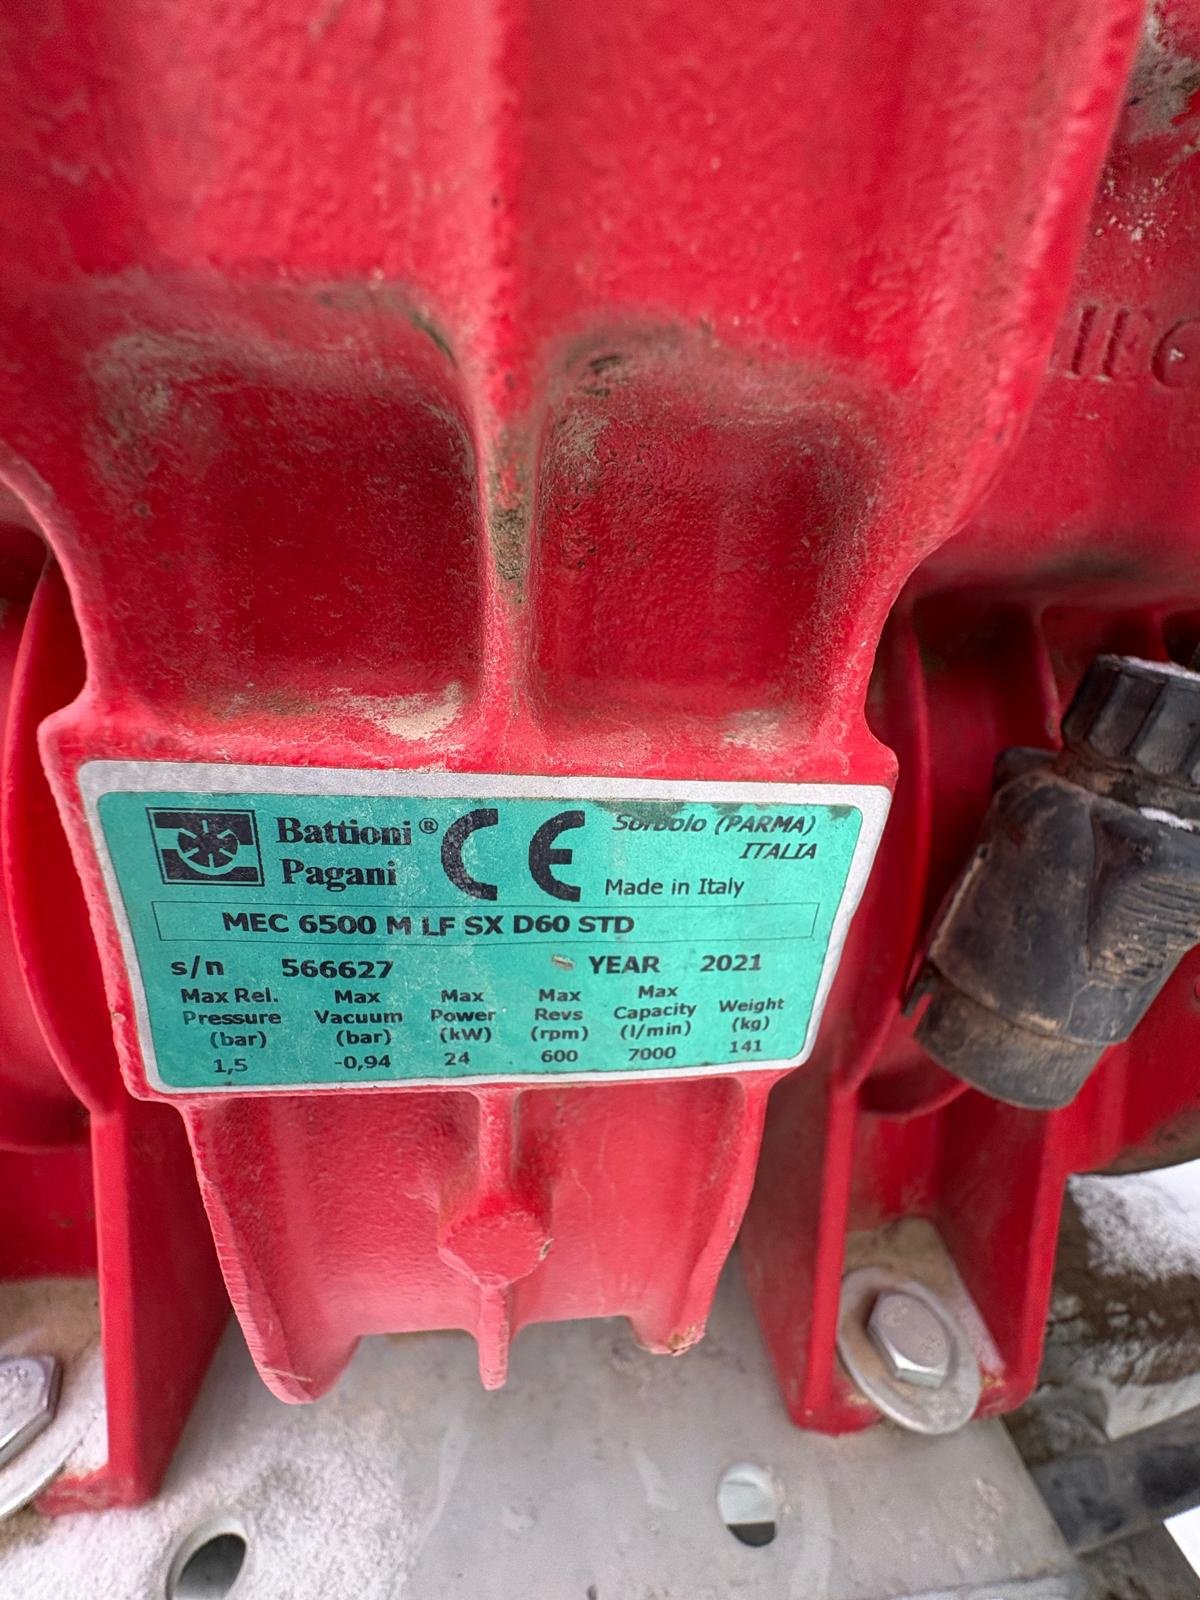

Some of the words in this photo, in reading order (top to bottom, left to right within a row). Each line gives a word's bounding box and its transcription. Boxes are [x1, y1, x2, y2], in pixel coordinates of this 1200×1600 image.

[273, 817, 412, 846] Battioni
[714, 815, 817, 836] (PARMA)
[739, 842, 818, 860] ITALIA
[278, 858, 398, 892] Pagani
[605, 877, 664, 896] Made
[671, 878, 690, 895] in
[697, 877, 745, 898] Italy
[222, 911, 290, 934] MEC
[298, 914, 377, 935] 6500
[386, 916, 412, 936] M
[421, 917, 456, 936] LF
[464, 915, 504, 935] SX
[513, 914, 571, 934] D60
[578, 915, 635, 934] STD
[170, 954, 225, 979] s/n
[282, 957, 394, 979] 566627
[588, 956, 661, 975] YEAR
[699, 953, 762, 973] 2021
[181, 987, 229, 1004] Max
[234, 987, 279, 1003] Rel.
[334, 989, 382, 1004] Max
[440, 989, 485, 1003] Max
[538, 988, 582, 1002] Max
[638, 984, 679, 999] Max
[534, 1007, 584, 1022] Revs
[613, 1002, 697, 1021] Capacity
[719, 997, 785, 1014] Weight
[183, 1010, 283, 1026] Pressure
[314, 1009, 403, 1025] Vacuum
[431, 1008, 497, 1023] Power
[731, 1015, 770, 1033] (kg)
[209, 1030, 268, 1049] (bar)
[336, 1028, 393, 1047] (bar)
[439, 1026, 493, 1044] (kW)
[530, 1025, 589, 1043] (rpm)
[628, 1046, 677, 1062] 7000
[729, 1039, 763, 1054] 141
[334, 1054, 392, 1072] -0,94
[444, 1052, 471, 1067] 24
[540, 1049, 579, 1064] 600
[213, 1058, 249, 1076] 1,5
